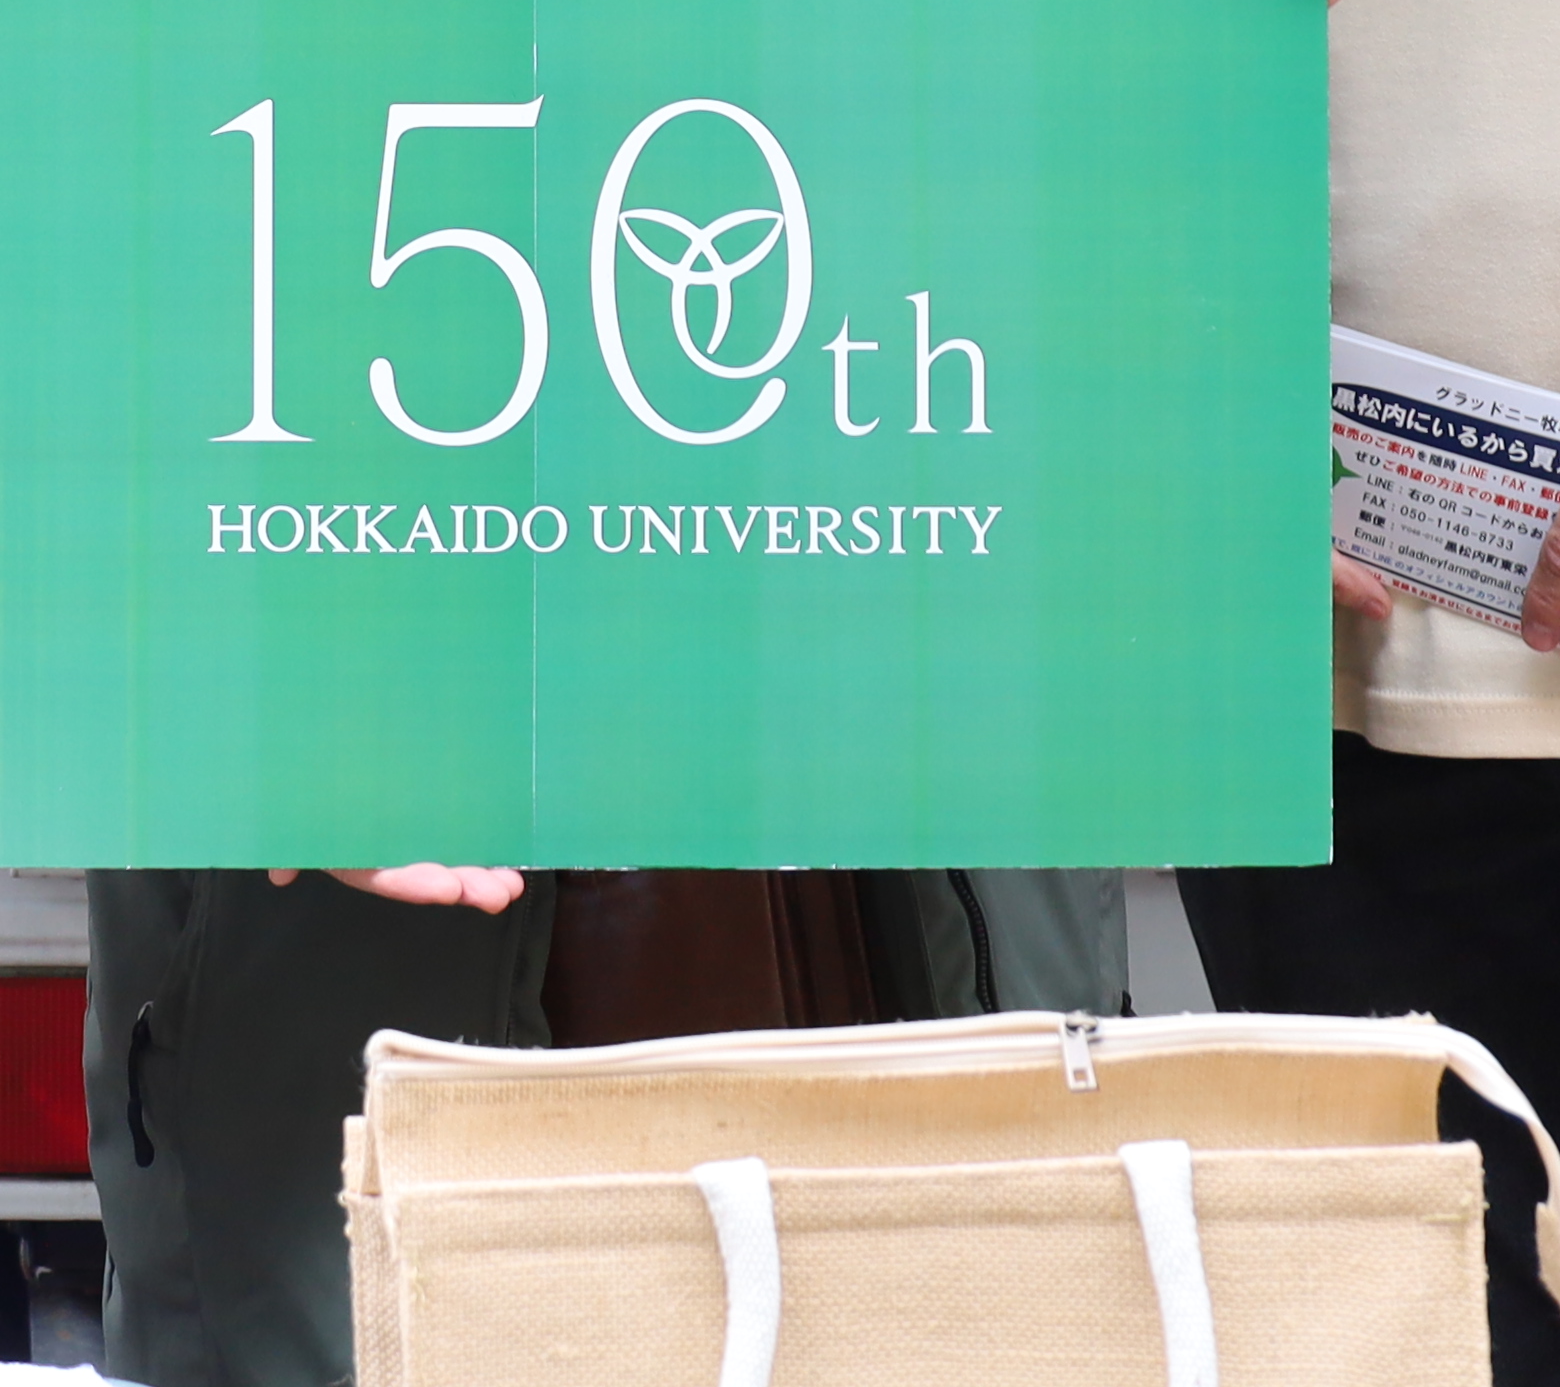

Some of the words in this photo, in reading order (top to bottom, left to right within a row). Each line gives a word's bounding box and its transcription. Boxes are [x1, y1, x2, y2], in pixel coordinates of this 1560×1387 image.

[207, 94, 993, 447] 150th
[1355, 451, 1557, 524] ぜひご希望の方法での事前登録
[207, 504, 568, 555] HOKKAIDO
[590, 504, 1002, 556] UNIVERSITY
